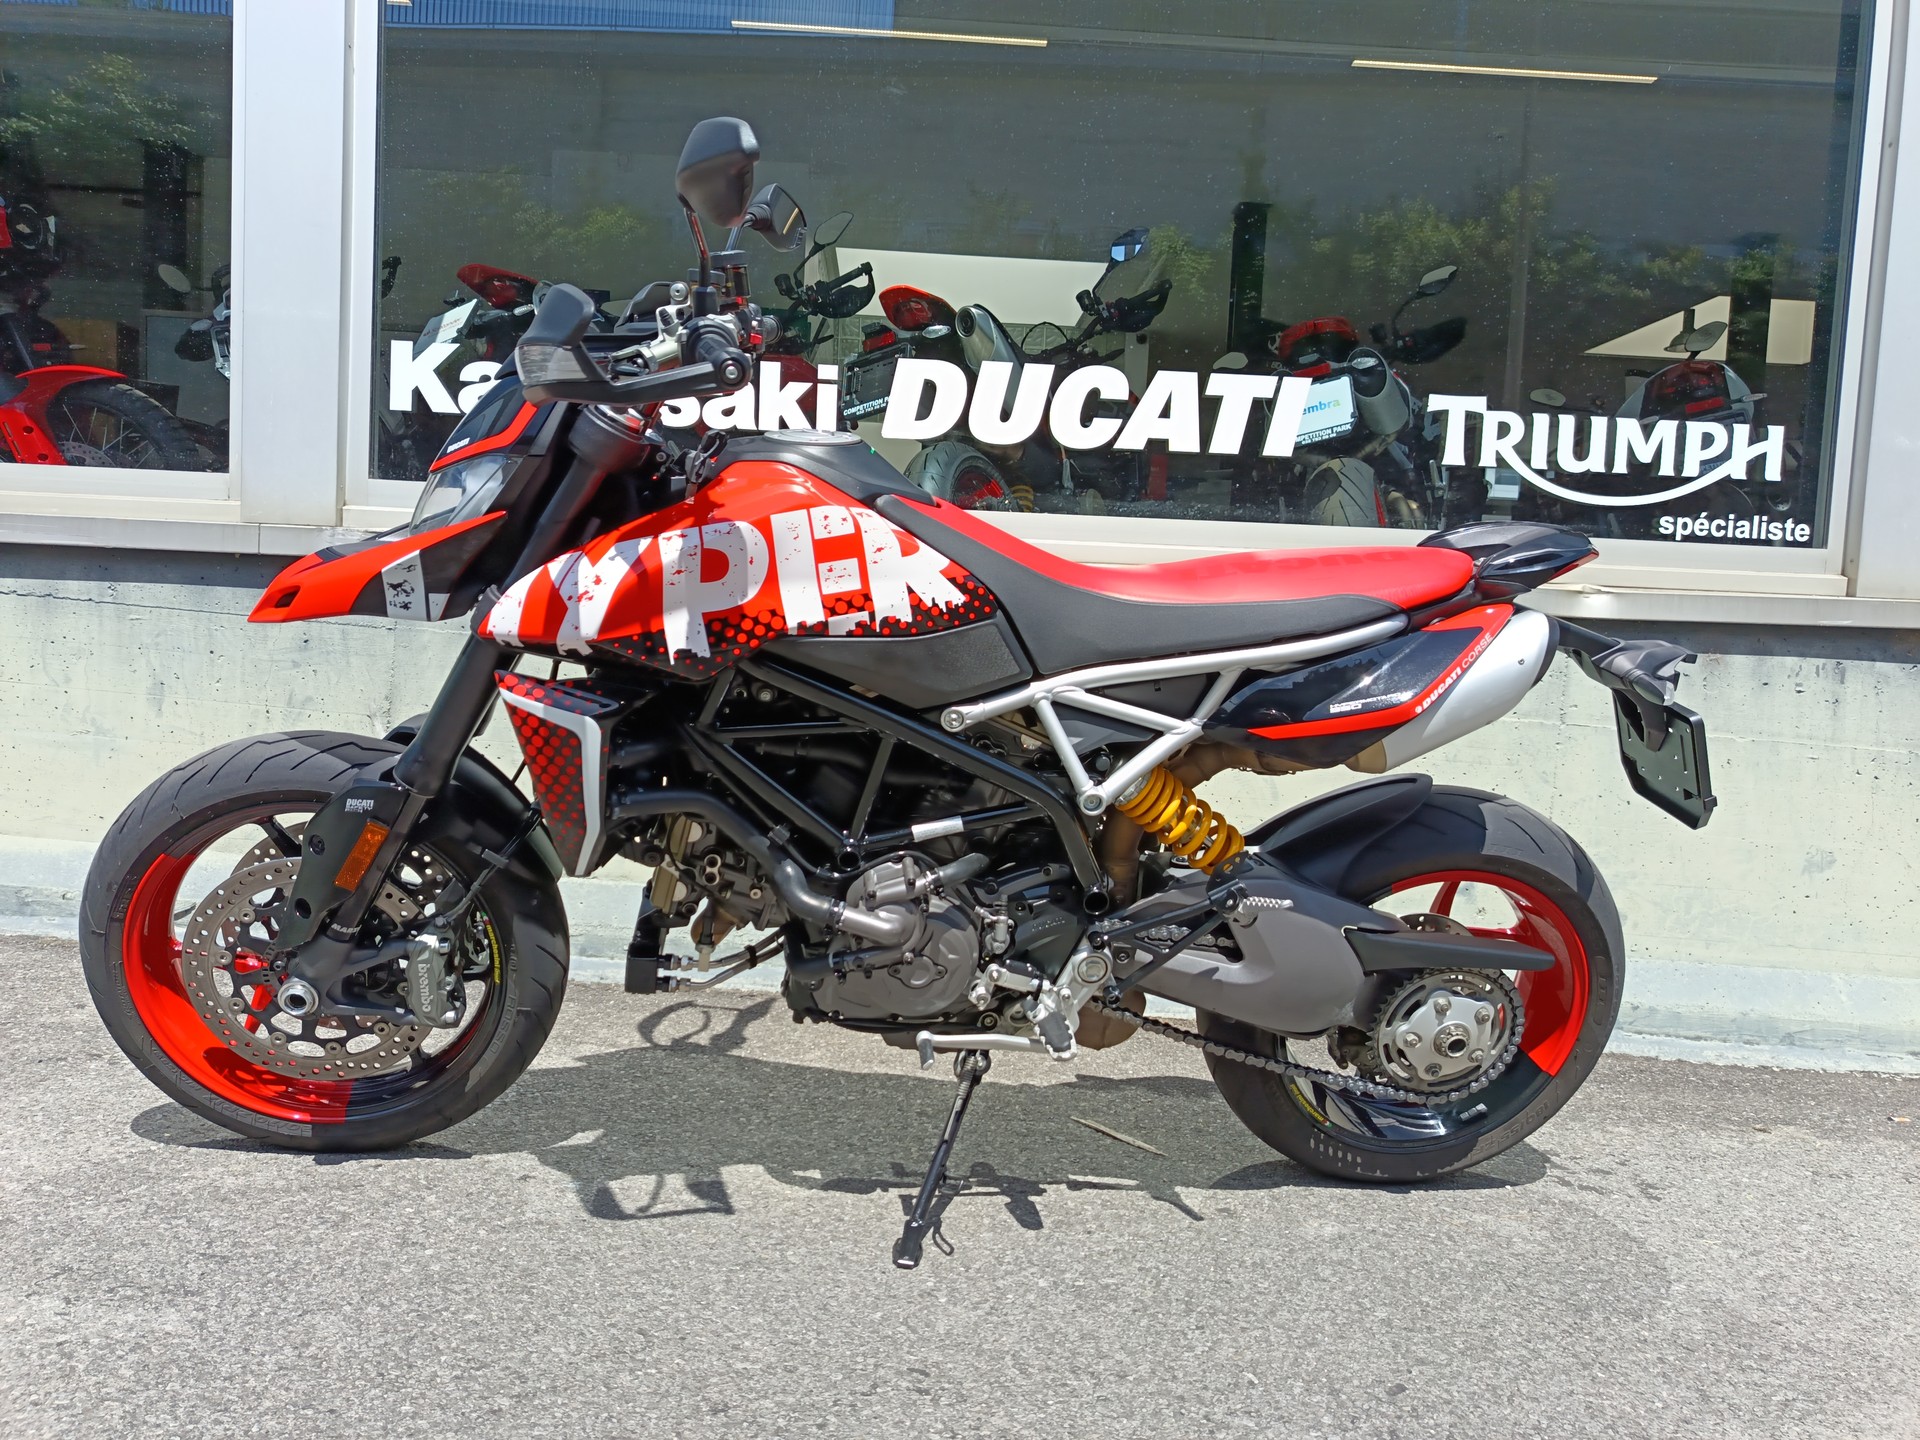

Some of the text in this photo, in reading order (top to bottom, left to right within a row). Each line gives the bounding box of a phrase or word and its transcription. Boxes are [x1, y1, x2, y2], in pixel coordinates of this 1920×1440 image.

[390, 339, 838, 431] Kasaki
[843, 398, 884, 416] COMPETITION
[881, 358, 1312, 457] DUCATI
[1303, 399, 1341, 415] embra
[1333, 423, 1352, 434] PARK
[1427, 393, 1785, 506] TRIUMPH
[1658, 511, 1811, 543] spécialiste
[1421, 632, 1494, 709] DUCATI CORSE
[346, 798, 375, 807] DUCATI
[418, 963, 434, 1012] brembo
